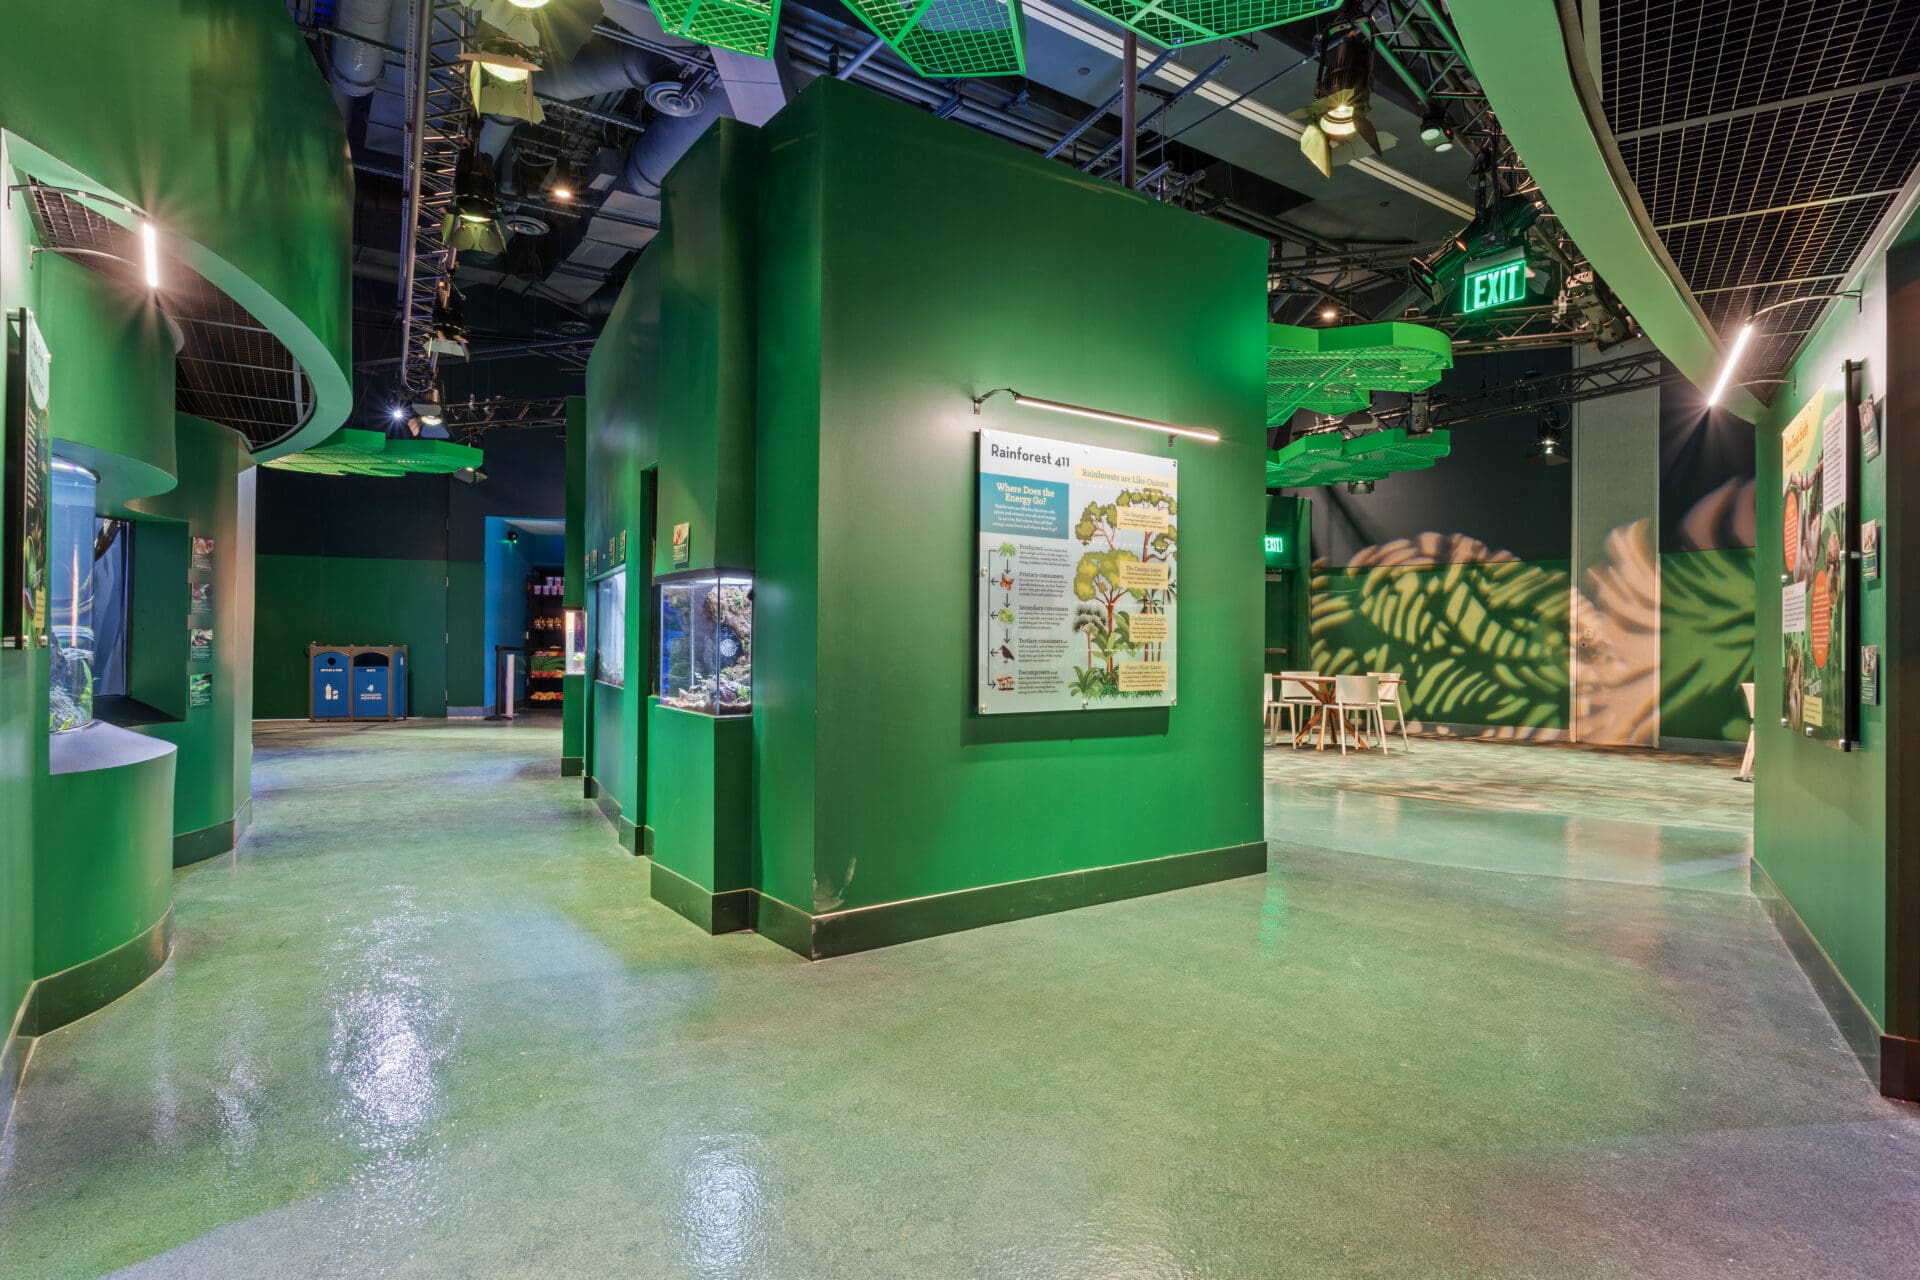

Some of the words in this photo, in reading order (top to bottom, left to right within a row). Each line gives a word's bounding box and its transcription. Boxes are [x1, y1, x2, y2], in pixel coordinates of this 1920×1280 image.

[1473, 265, 1519, 309] EXIT
[991, 443, 1052, 465] Rainforest
[1054, 457, 1070, 468] 411
[1081, 468, 1120, 481] Rainforests
[1132, 475, 1146, 484] Like
[1147, 478, 1168, 488] Onions
[996, 482, 1022, 494] Where
[1023, 485, 1041, 496] Does
[1042, 488, 1055, 497] the
[1005, 492, 1032, 506] Energy
[1032, 496, 1046, 506] Go?
[1265, 537, 1280, 552] EXIT
